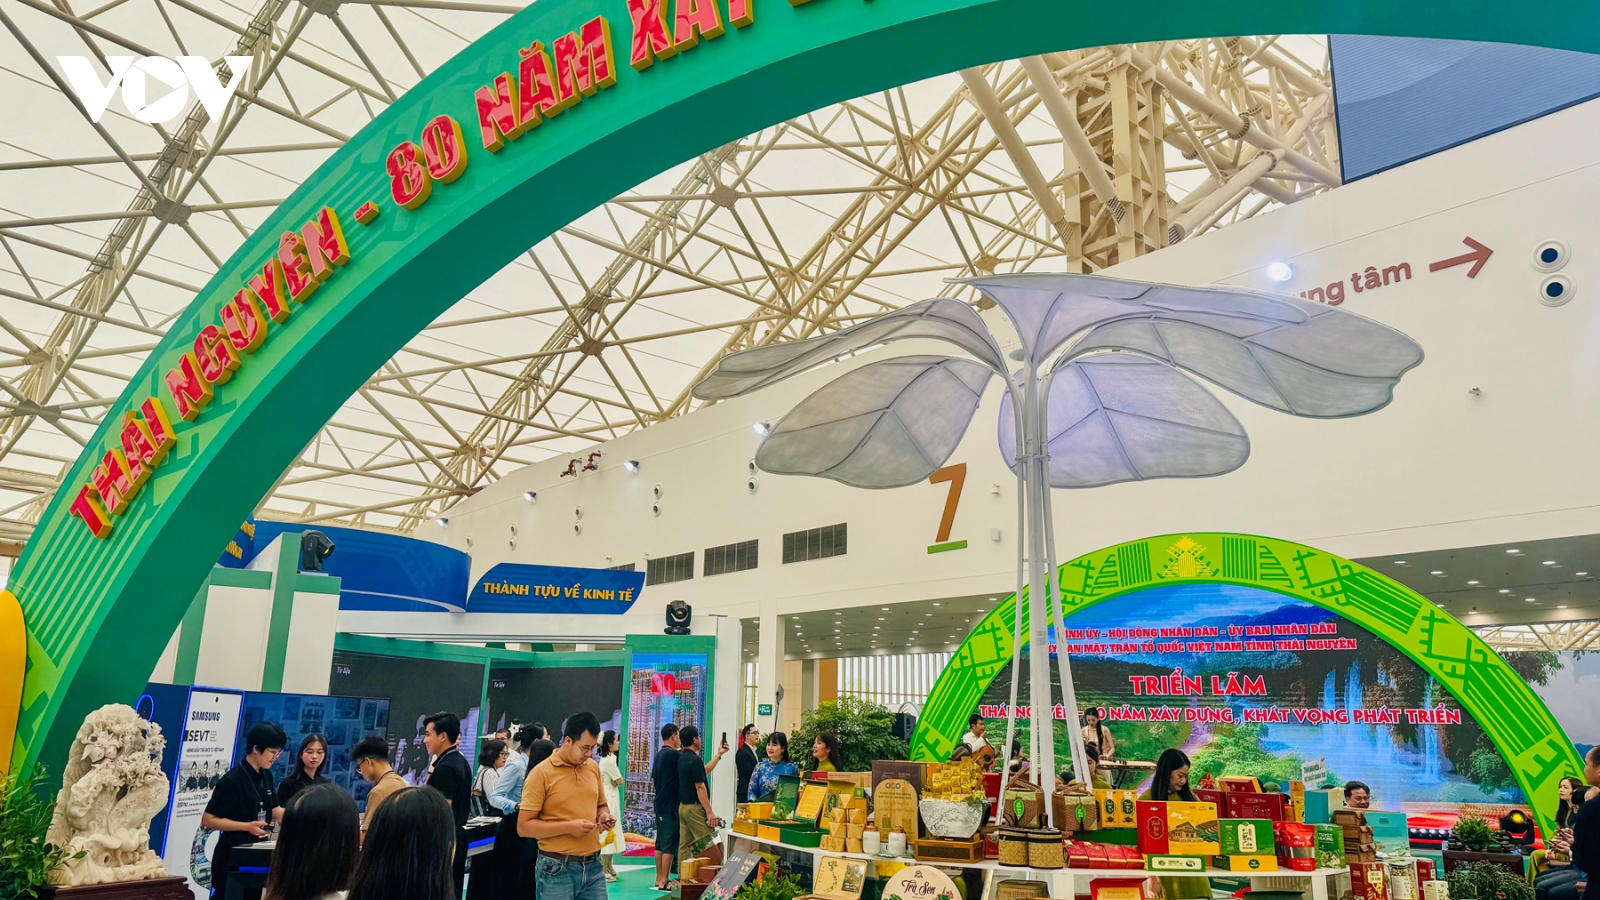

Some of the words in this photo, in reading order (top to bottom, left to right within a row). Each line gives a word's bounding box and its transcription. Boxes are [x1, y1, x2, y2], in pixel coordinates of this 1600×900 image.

[68, 396, 177, 539] THÁI
[164, 206, 350, 422] NGUYÊN
[386, 114, 468, 210] 80
[474, 15, 616, 154] NĂM
[1350, 262, 1412, 293] tâm
[929, 463, 966, 541] 7
[483, 580, 529, 596] THÀNH
[534, 584, 560, 600] TỰU
[564, 582, 581, 599] VỀ
[583, 588, 615, 601] KINH
[618, 587, 635, 602] TẾ
[1109, 628, 1126, 640] HỘI
[1129, 626, 1158, 638] ĐỒNG
[1160, 626, 1193, 638] NHÂN
[1194, 625, 1218, 637] DÂN
[1246, 625, 1271, 635] BAN
[1273, 623, 1308, 635] NHÂN
[1311, 622, 1337, 634] DÂN
[1068, 644, 1082, 653] AN
[1084, 643, 1107, 655] MẶT
[1109, 642, 1138, 654] TRẬN
[1141, 639, 1155, 652] TỔ
[1157, 640, 1185, 654] QUỐC
[1187, 640, 1212, 653] VIỆT
[1215, 642, 1242, 651] NAM
[1275, 638, 1305, 650] THÁI
[1306, 637, 1357, 650] NGUYÊN
[651, 673, 675, 696] 80
[1129, 668, 1204, 696] TRIỂN
[1211, 672, 1267, 696] LÃM
[191, 711, 221, 721] SAMSUNG
[1110, 706, 1146, 721] NĂM
[1148, 706, 1183, 721] XÂY
[1243, 705, 1292, 723] KHÁT
[1292, 708, 1349, 725] VỌNG
[1353, 705, 1402, 723] PHÁT
[1405, 703, 1461, 724] TRIỂN
